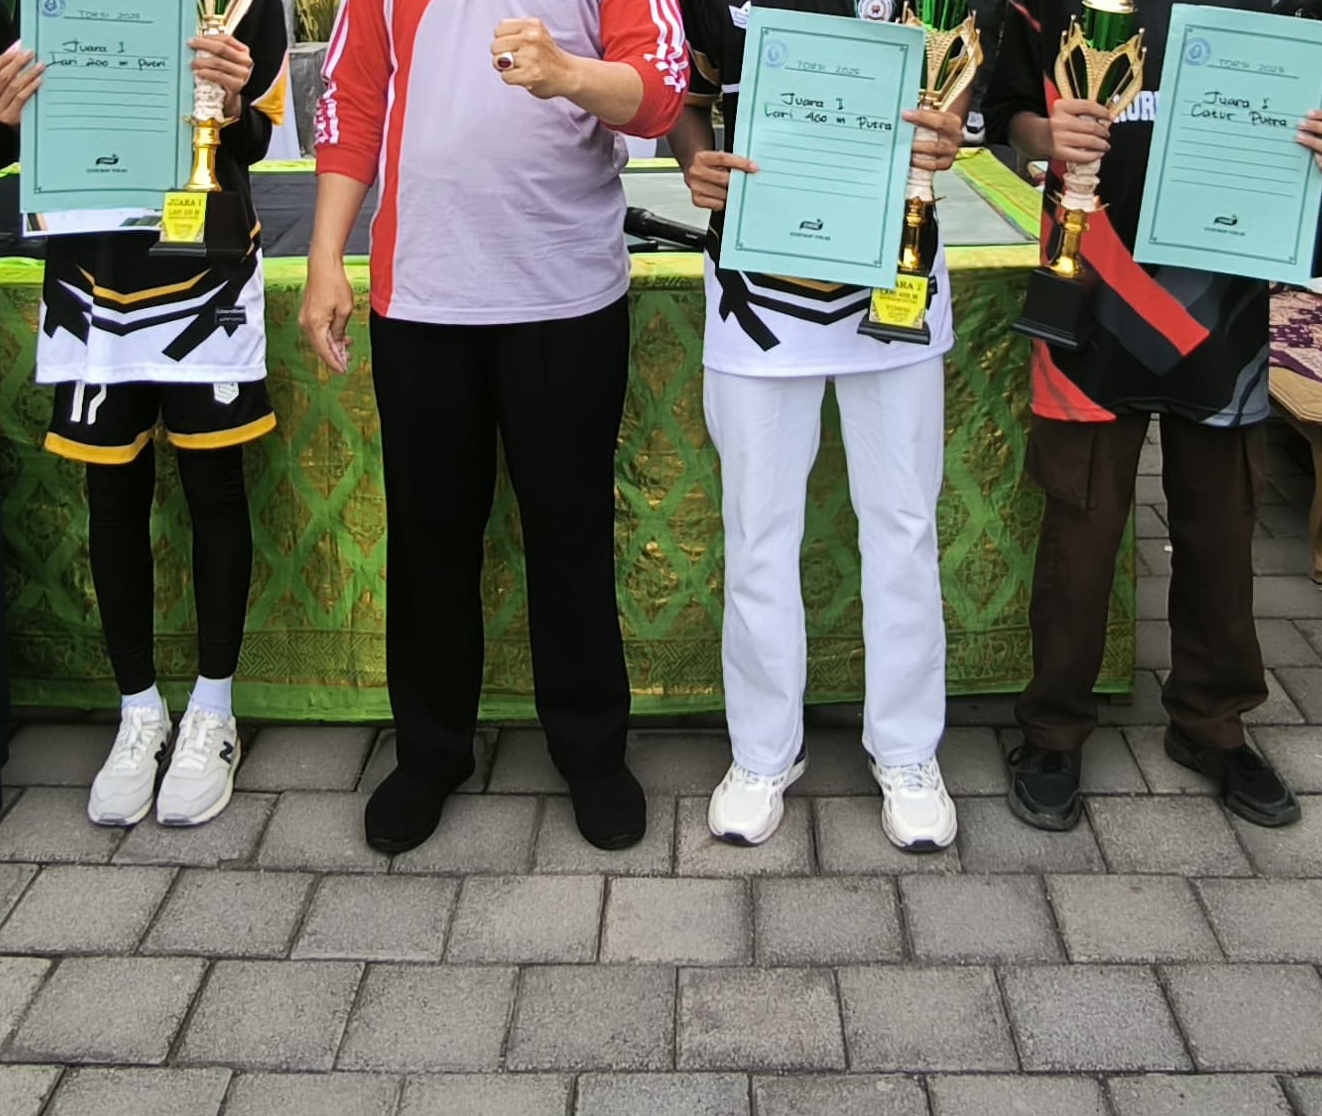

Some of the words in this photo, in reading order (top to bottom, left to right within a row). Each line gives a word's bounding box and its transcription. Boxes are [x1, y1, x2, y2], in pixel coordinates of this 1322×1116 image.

[62, 40, 107, 53] Juara
[780, 92, 824, 108] Juara
[1204, 91, 1250, 109] Juara
[1248, 110, 1288, 128] Putra
